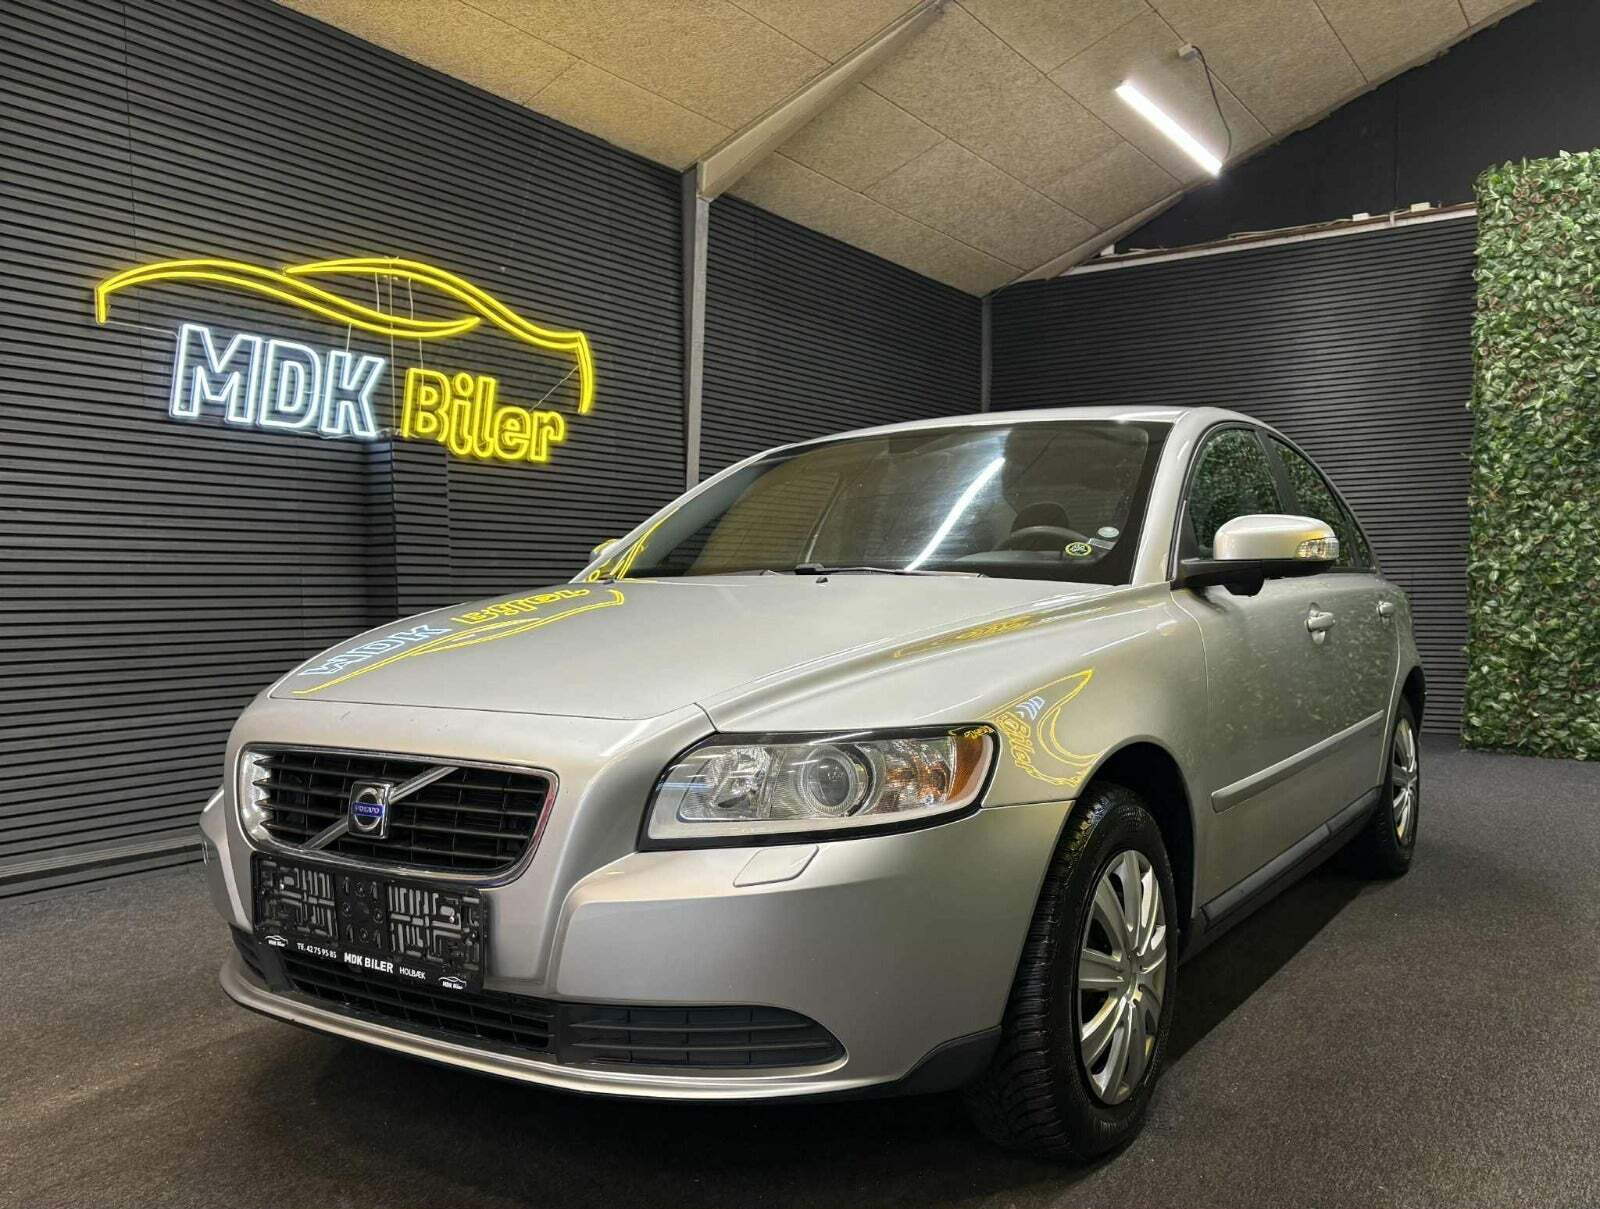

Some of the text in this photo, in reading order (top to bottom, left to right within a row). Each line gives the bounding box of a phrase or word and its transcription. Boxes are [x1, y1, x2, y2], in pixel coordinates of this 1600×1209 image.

[169, 323, 567, 463] MDK Biler
[344, 952, 394, 974] MDK BILER
